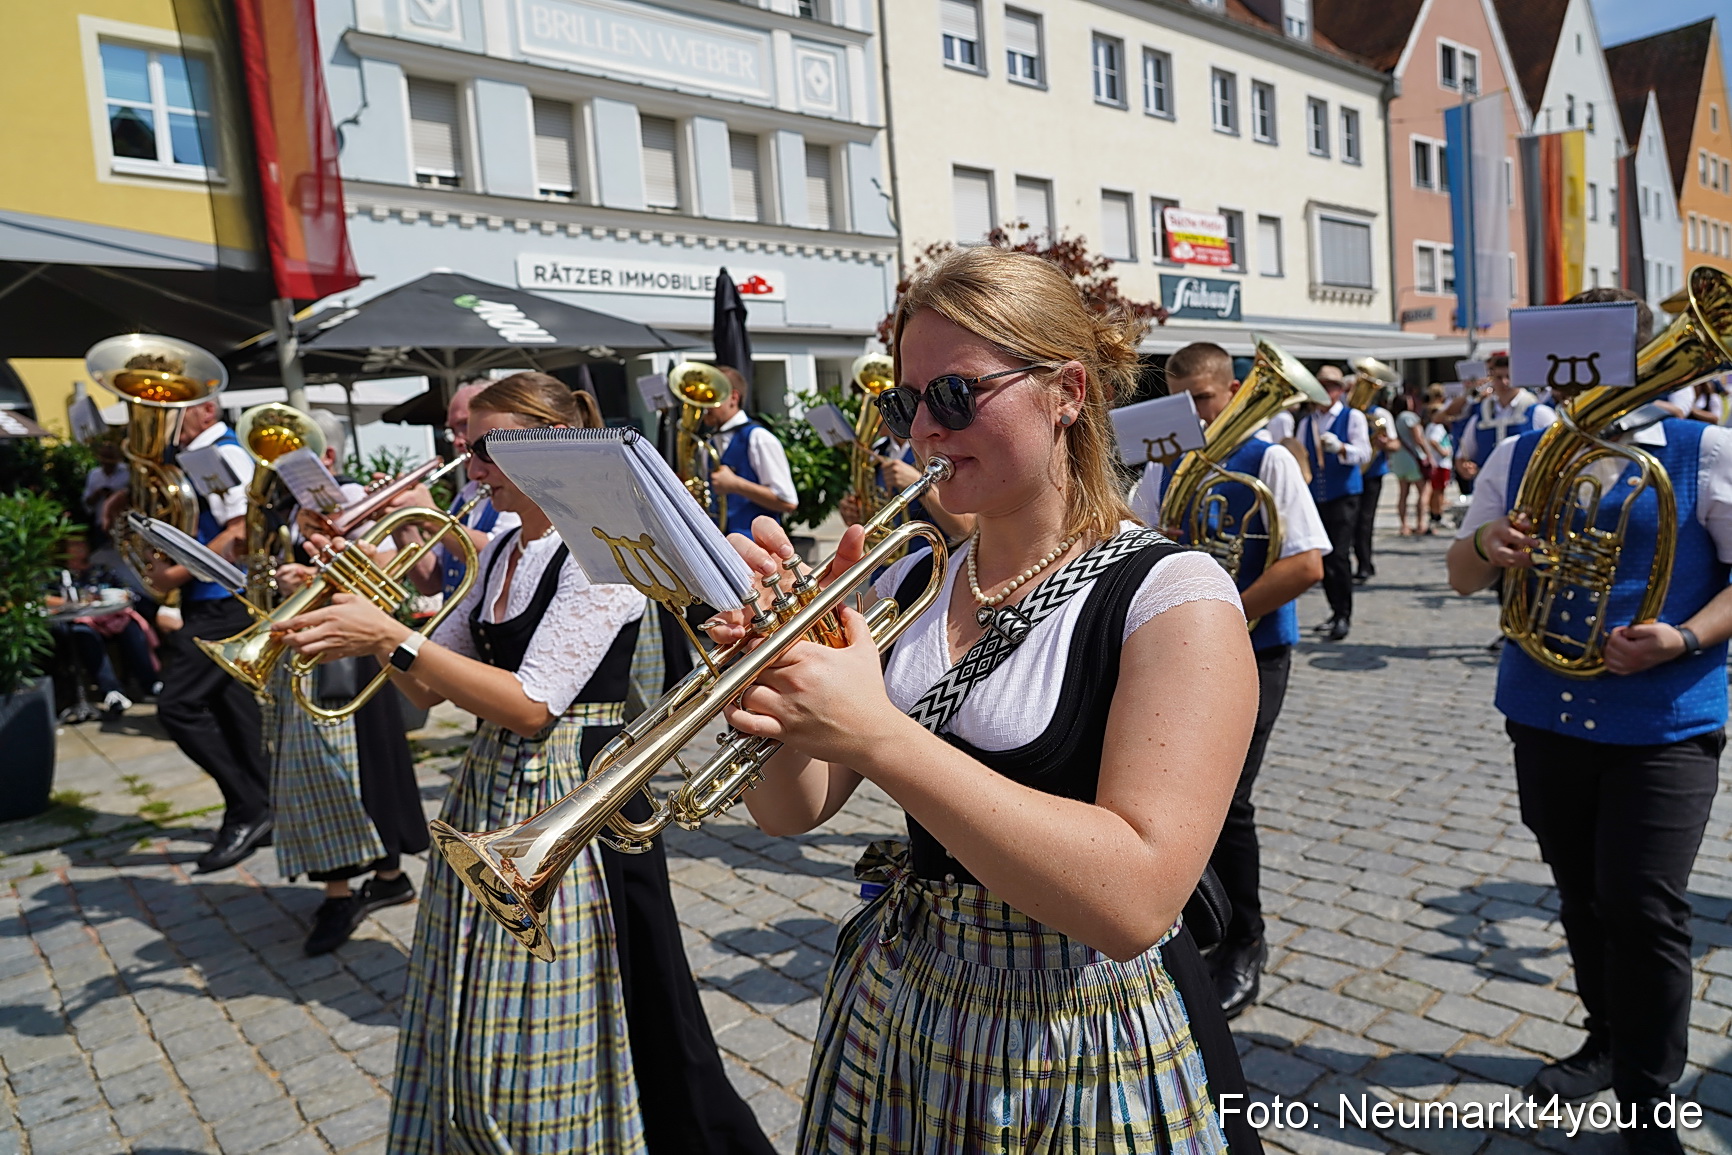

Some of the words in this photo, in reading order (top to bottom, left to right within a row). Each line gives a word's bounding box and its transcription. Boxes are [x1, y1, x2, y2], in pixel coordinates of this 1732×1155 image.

[531, 4, 653, 59] BRILLEN
[656, 31, 756, 81] WEBER
[534, 262, 613, 286] RÄTZER
[619, 271, 716, 292] IMMOBILIE
